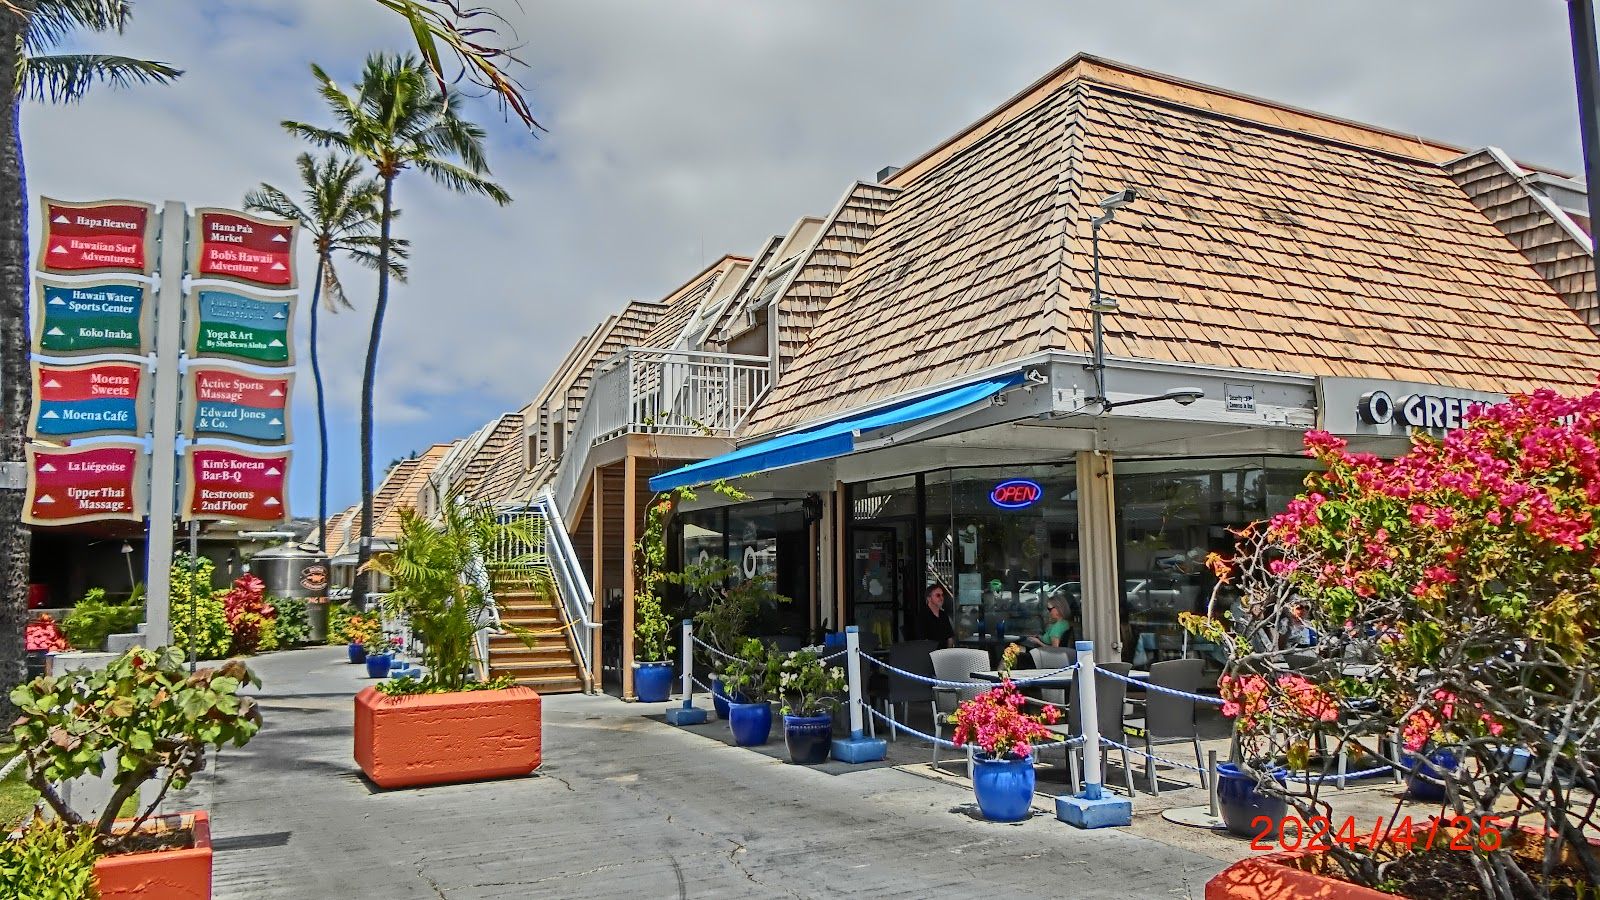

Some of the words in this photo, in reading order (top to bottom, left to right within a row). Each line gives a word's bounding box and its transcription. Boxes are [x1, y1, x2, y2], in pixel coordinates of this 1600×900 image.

[76, 216, 102, 228] Hapa
[102, 218, 137, 230] Heaven
[211, 222, 236, 232] Hana
[211, 233, 243, 243] Market
[70, 240, 115, 252] Hawaiian
[115, 244, 136, 253] Surf
[80, 252, 135, 264] Adventures
[210, 250, 237, 261] Bob's
[238, 252, 273, 264] Hawaii
[210, 261, 259, 273] Adventure
[72, 290, 105, 301] Hawaii
[105, 292, 135, 303] Water
[68, 301, 100, 313] Sports
[101, 303, 134, 314] Center
[79, 328, 103, 338] Koko
[104, 329, 133, 340] Inaba
[206, 329, 229, 341] Yoga
[229, 330, 237, 340] &
[238, 332, 253, 340] Art
[206, 340, 216, 348] By
[90, 373, 130, 385] Moena
[201, 378, 231, 389] Active
[233, 380, 264, 392] Sports
[91, 384, 130, 396] Sweets
[200, 388, 243, 403] Massage
[62, 409, 102, 421] Moena
[103, 410, 128, 422] Café
[200, 407, 238, 418] Edward
[239, 408, 266, 421] Jones
[199, 418, 209, 428] &
[211, 418, 229, 428] Co.
[68, 461, 81, 471] La
[202, 459, 229, 469] Kim's
[230, 459, 265, 470] Korean
[202, 470, 242, 482] Bar-B-Q
[67, 487, 100, 500] Upper
[101, 487, 125, 498] Thai
[201, 489, 255, 499] Restrooms
[994, 486, 1037, 501] OPEN
[79, 500, 125, 512] Massage
[201, 500, 221, 511] 2nd
[222, 501, 248, 511] Floor
